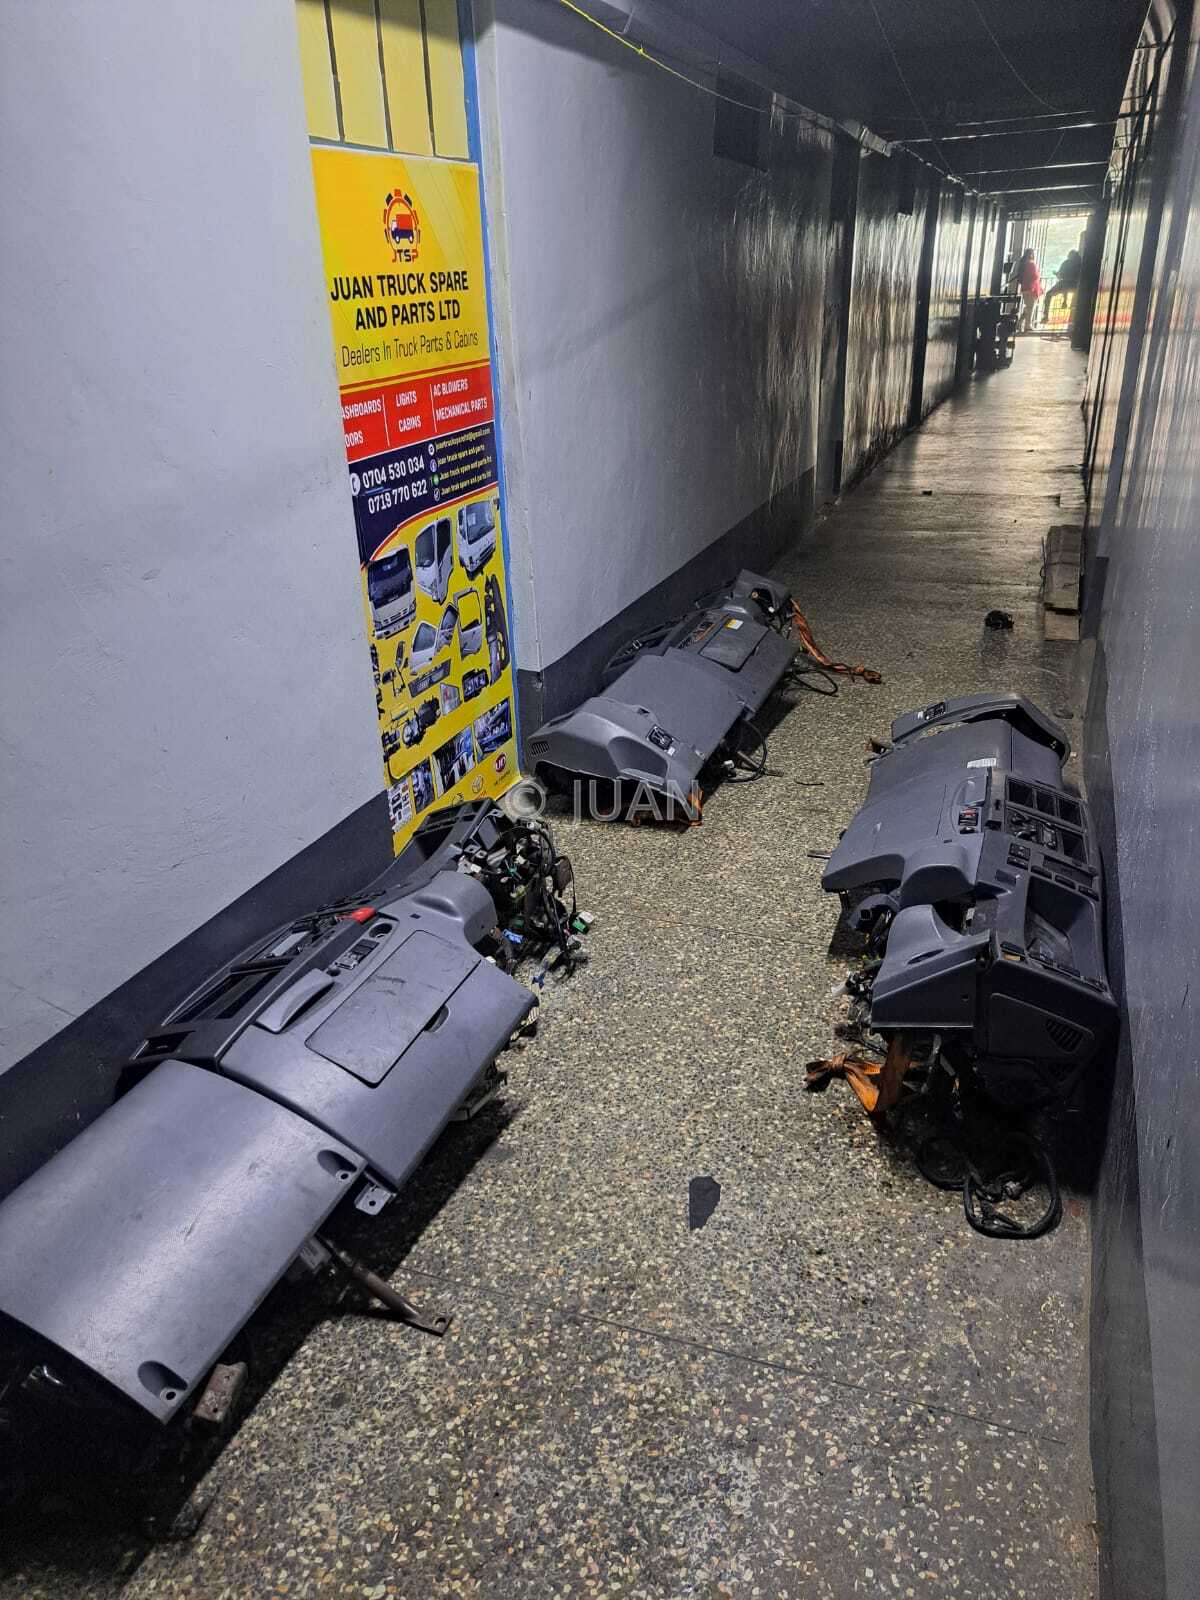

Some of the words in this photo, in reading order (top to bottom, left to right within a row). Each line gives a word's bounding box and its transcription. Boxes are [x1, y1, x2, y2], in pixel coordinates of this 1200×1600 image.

[392, 248, 418, 263] JTSP
[330, 274, 374, 300] JUAN
[377, 272, 425, 296] TRUCK
[430, 270, 469, 293] SPARE
[355, 306, 387, 330] AND
[392, 302, 435, 326] PARTS
[440, 300, 460, 321] LTD
[342, 344, 380, 367] Dealers
[383, 340, 391, 359] In
[394, 336, 418, 356] Truck
[420, 334, 443, 354] Parts
[446, 334, 452, 350] &
[454, 330, 478, 350] Cabins
[396, 390, 417, 407] LIGHTS
[433, 384, 442, 397] AC
[442, 378, 468, 395] BLOWERS
[436, 403, 471, 421] MECHANICAL
[471, 398, 487, 413] PARTS
[399, 415, 421, 432] CABINS
[362, 466, 386, 488] 0704
[388, 460, 406, 480] 530
[407, 454, 424, 474] 034
[368, 492, 392, 514] 0719
[392, 485, 410, 504] 770
[412, 479, 428, 498] 622
